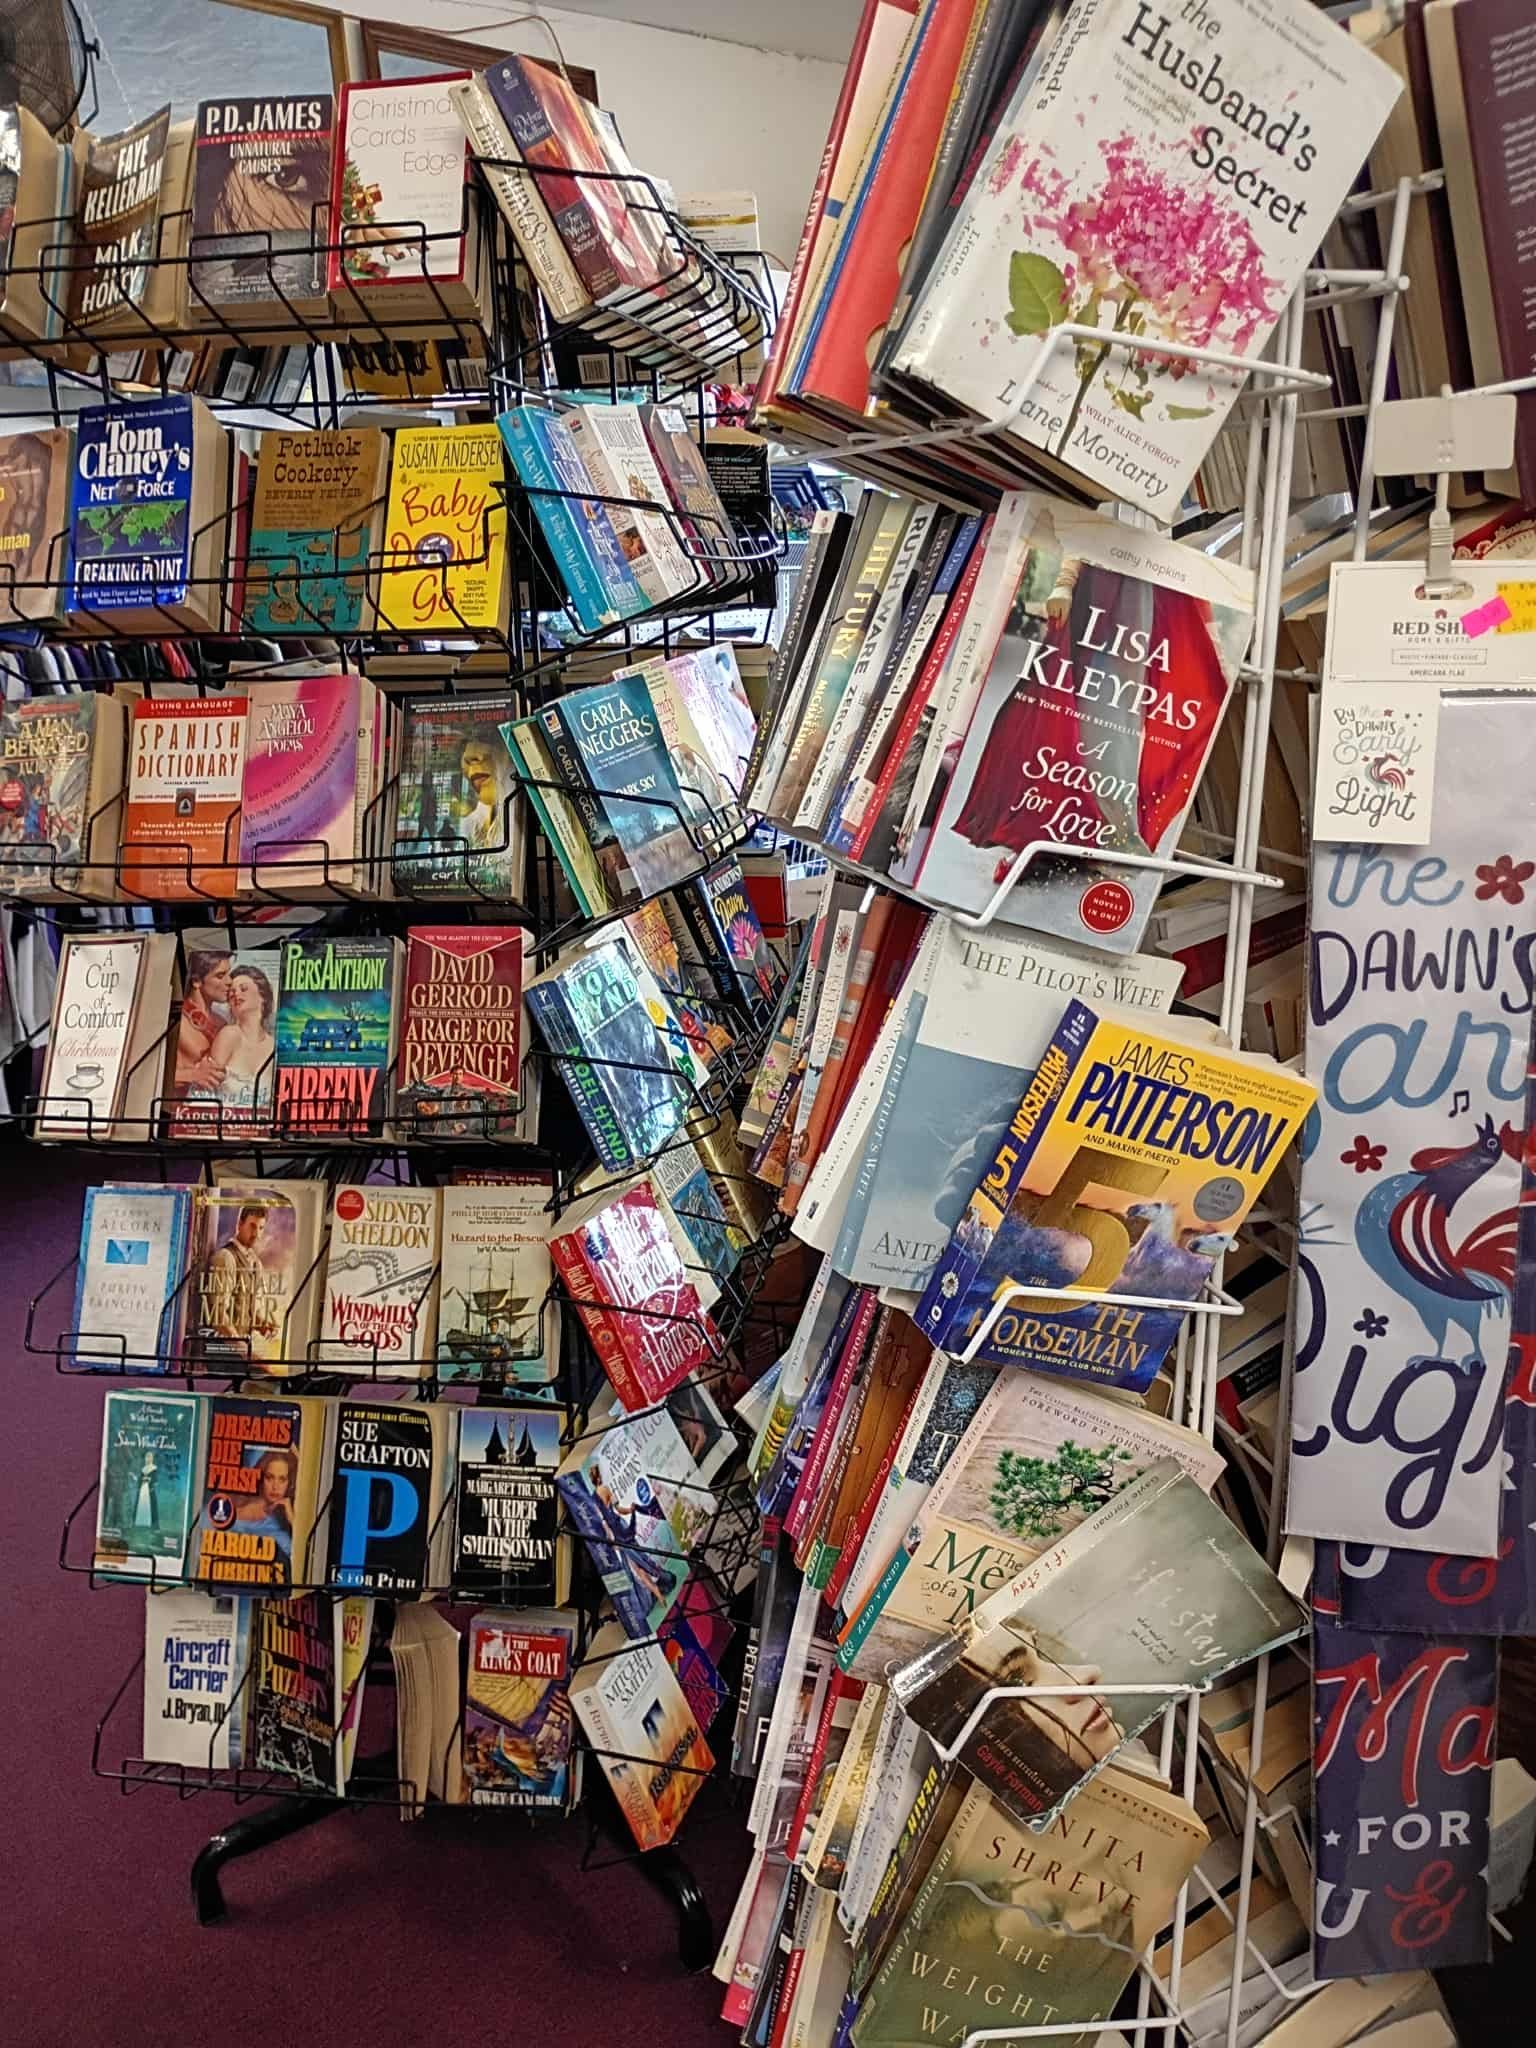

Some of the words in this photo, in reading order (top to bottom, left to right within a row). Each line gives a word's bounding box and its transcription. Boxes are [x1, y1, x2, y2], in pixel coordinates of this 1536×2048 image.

[1179, 0, 1221, 40] the
[1032, 2, 1084, 85] Secret
[1122, 1, 1318, 173] Husband's
[246, 102, 321, 131] JAMES
[229, 140, 292, 158] UNNATURAL
[350, 124, 417, 149] Cards
[116, 134, 149, 180] FAYE
[240, 158, 281, 174] CAUSES
[402, 151, 458, 176] Edge
[816, 141, 835, 178] THE
[1189, 125, 1310, 234] Secret
[777, 237, 810, 321] ANSWER
[106, 421, 162, 453] Tom
[278, 437, 362, 459] Potluck
[399, 441, 435, 468] SUSAN
[442, 439, 504, 467] ANDERSEN
[997, 379, 1064, 434] Lane
[1072, 428, 1169, 498] Moriarty
[1084, 403, 1114, 430] WHAT
[1113, 421, 1145, 446] ALICE
[1142, 439, 1181, 469] FORGOT
[79, 442, 190, 482] Clancy's
[272, 462, 357, 488] Cookery
[137, 479, 175, 497] FORCE
[401, 478, 487, 533] Baby
[855, 530, 890, 584] THE
[886, 514, 928, 591] RUTH
[1110, 545, 1142, 568] cathy
[1145, 559, 1188, 583] hopkins
[829, 592, 874, 660] FURY
[853, 598, 893, 677] WARE
[883, 599, 923, 678] HANNAH
[1077, 606, 1171, 674] LISA
[1392, 622, 1429, 635] RED
[890, 612, 936, 696] Selected
[918, 636, 954, 693] TWINS
[946, 620, 983, 712] FRIEND
[1016, 640, 1202, 731] KLEYPAS
[185, 701, 233, 709] LANGUAGE
[271, 703, 306, 720] MAYA
[580, 699, 633, 732] CARLA
[787, 677, 828, 763] MICHAELIDES
[829, 684, 859, 748] ZERO
[1014, 691, 1037, 705] NEW
[1037, 698, 1063, 714] YORK
[1064, 706, 1092, 724] TIMES
[1093, 715, 1147, 739] BESTSELLING
[1148, 735, 1183, 751] AUTHOR
[1333, 707, 1356, 726] By
[140, 722, 240, 750] SPANISH
[259, 718, 316, 738] ANGELOU
[578, 716, 654, 760] NEGGERS
[757, 708, 774, 741] TOM
[857, 705, 894, 766] Poems
[268, 739, 303, 758] POEMS
[929, 723, 948, 762] ME
[1075, 740, 1112, 761] A
[1333, 728, 1423, 766] Early
[137, 753, 238, 778] DICTIONARY
[809, 747, 836, 789] DAYS
[1022, 745, 1139, 806] Season
[640, 774, 657, 795] SKY
[1010, 787, 1053, 813] for
[1328, 777, 1418, 828] Light
[1040, 796, 1118, 847] Love
[1325, 841, 1465, 911] the
[714, 894, 750, 928] Dawn
[1093, 897, 1124, 912] NOVELS
[1103, 889, 1121, 899] TWO
[101, 949, 112, 967] A
[284, 943, 322, 991] PIERS
[321, 943, 388, 991] ANTHONY
[431, 949, 494, 984] DAVID
[958, 940, 1013, 977] THE
[1014, 952, 1107, 998] PILOT'S
[1111, 976, 1166, 1010] WIFE
[85, 964, 120, 994] Cup
[411, 983, 513, 1009] GERROLD
[93, 991, 110, 1009] of
[63, 1005, 125, 1031] Comfort
[406, 1019, 417, 1041] A
[421, 1019, 473, 1043] RAGE
[476, 1020, 515, 1044] FOR
[405, 1043, 515, 1087] REVENGE
[1109, 1039, 1195, 1087] JAMES
[1008, 1043, 1069, 1143] PATTERSON
[594, 1102, 629, 1163] HYND
[1065, 1061, 1289, 1175] PATTERSON
[1083, 1132, 1104, 1148] AND
[1104, 1138, 1143, 1158] MAXINE
[1144, 1148, 1181, 1167] PAETRO
[366, 1200, 433, 1224] SIDNEY
[342, 1222, 430, 1248] SHELDON
[451, 1233, 485, 1242] Hazard
[487, 1234, 496, 1242] to
[514, 1233, 545, 1242] Rescu
[874, 1231, 946, 1264] ANITA
[564, 1262, 586, 1291] Jude
[329, 1288, 418, 1333] WINDMILLS
[340, 1322, 403, 1350] GODS
[836, 1329, 866, 1391] SOLSTICE
[996, 1346, 1032, 1362] WOMEN'S
[1034, 1353, 1067, 1369] MURDER
[1068, 1359, 1090, 1372] CLUB
[1090, 1364, 1116, 1377] NOVEL
[213, 1413, 291, 1443] DREAMS
[341, 1421, 379, 1442] SUE
[959, 1401, 993, 1453] MEASURE
[1019, 1395, 1089, 1429] FOREWORD
[1090, 1426, 1105, 1437] BY
[1108, 1432, 1141, 1452] JOHN
[210, 1439, 242, 1464] DIE
[340, 1442, 431, 1468] GRAFTON
[208, 1466, 262, 1493] FIRST
[466, 1479, 515, 1496] MARGARET
[517, 1484, 554, 1498] TRUMAN
[481, 1498, 538, 1520] MURDER
[337, 1468, 420, 1587] P
[488, 1520, 503, 1537] IN
[505, 1520, 531, 1538] THE
[202, 1530, 276, 1561] HAROLD
[462, 1535, 553, 1560] SMITHSONIAN
[995, 1547, 1030, 1572] The
[886, 1558, 902, 1588] GENE
[1009, 1568, 1043, 1599] stay
[854, 1602, 876, 1635] GETZ
[163, 1637, 231, 1667] Aircraft
[512, 1639, 529, 1649] THE
[1168, 1608, 1229, 1668] stay
[169, 1665, 228, 1694] Carrier
[527, 1651, 561, 1675] COAT
[739, 1644, 758, 1715] PERETTI
[975, 1743, 1005, 1776] Gayle
[1002, 1770, 1045, 1815] Forman
[1051, 1814, 1144, 1872] NITA
[1357, 1810, 1472, 1856] FOR
[985, 1836, 1141, 1916] SHREVE
[908, 1873, 941, 1929] WEIGHT
[880, 1943, 902, 1986] WATER
[996, 1936, 1053, 1973] THE
[911, 1951, 1059, 2025] WEIGHT
